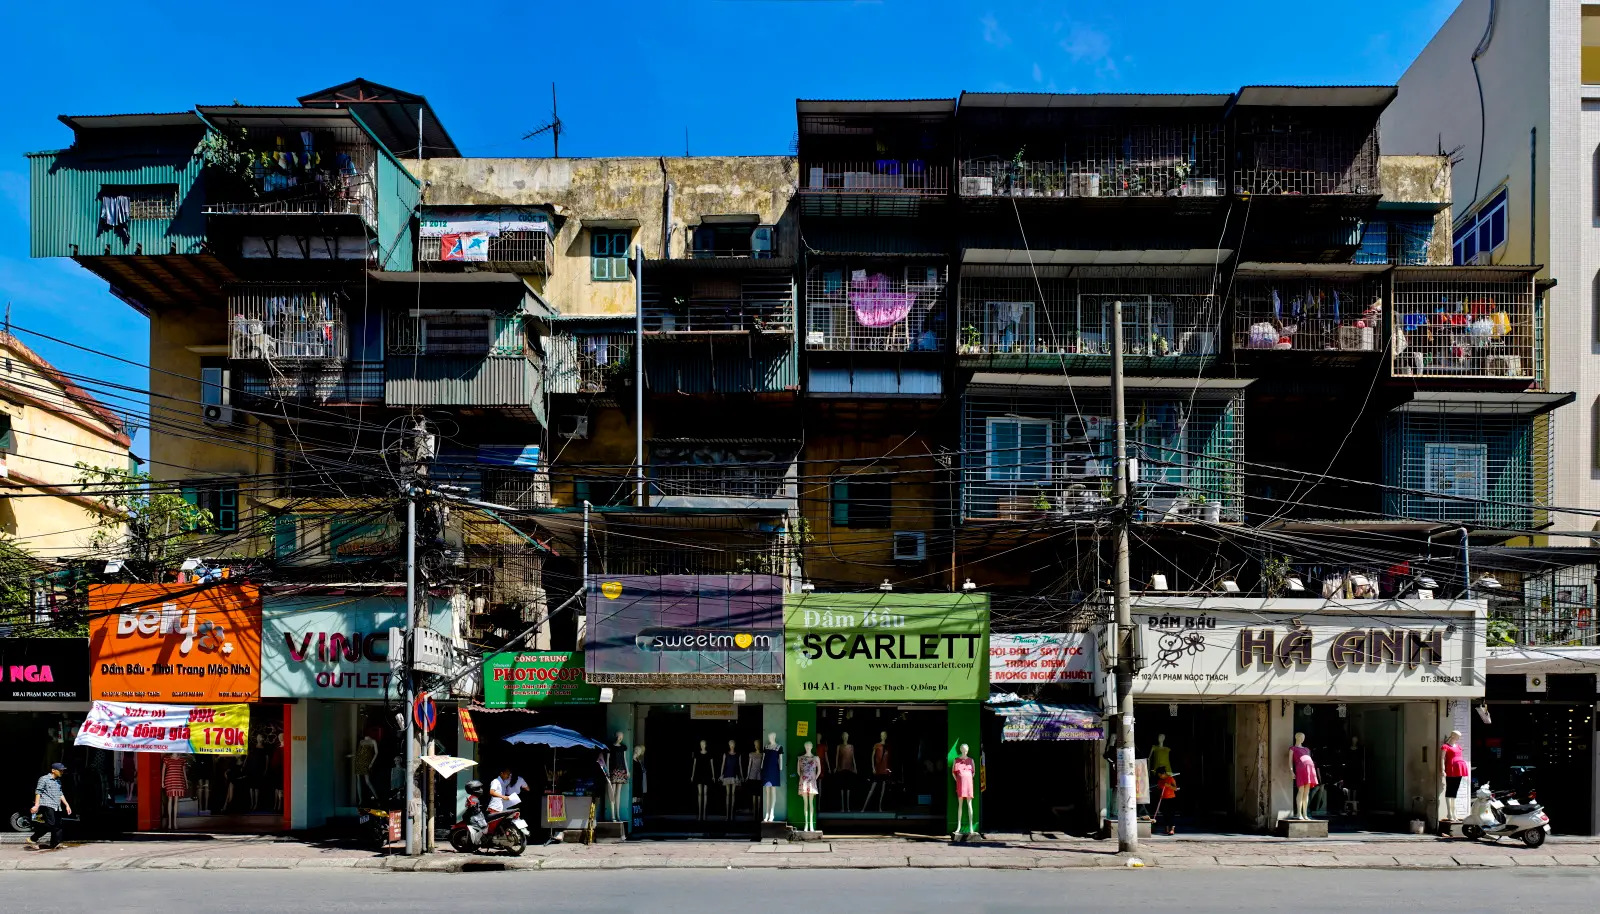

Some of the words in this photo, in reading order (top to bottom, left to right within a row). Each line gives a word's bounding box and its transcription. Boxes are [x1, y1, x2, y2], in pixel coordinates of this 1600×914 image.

[117, 602, 197, 653] Belly
[803, 634, 982, 660] SCARLETT
[1332, 629, 1442, 670] ANH
[10, 665, 54, 683] NGA
[176, 664, 205, 677] Trang
[869, 662, 974, 670] www.dambauscarlett.com
[802, 682, 819, 691] 104
[822, 682, 835, 691] A1
[203, 728, 245, 746] 179k
